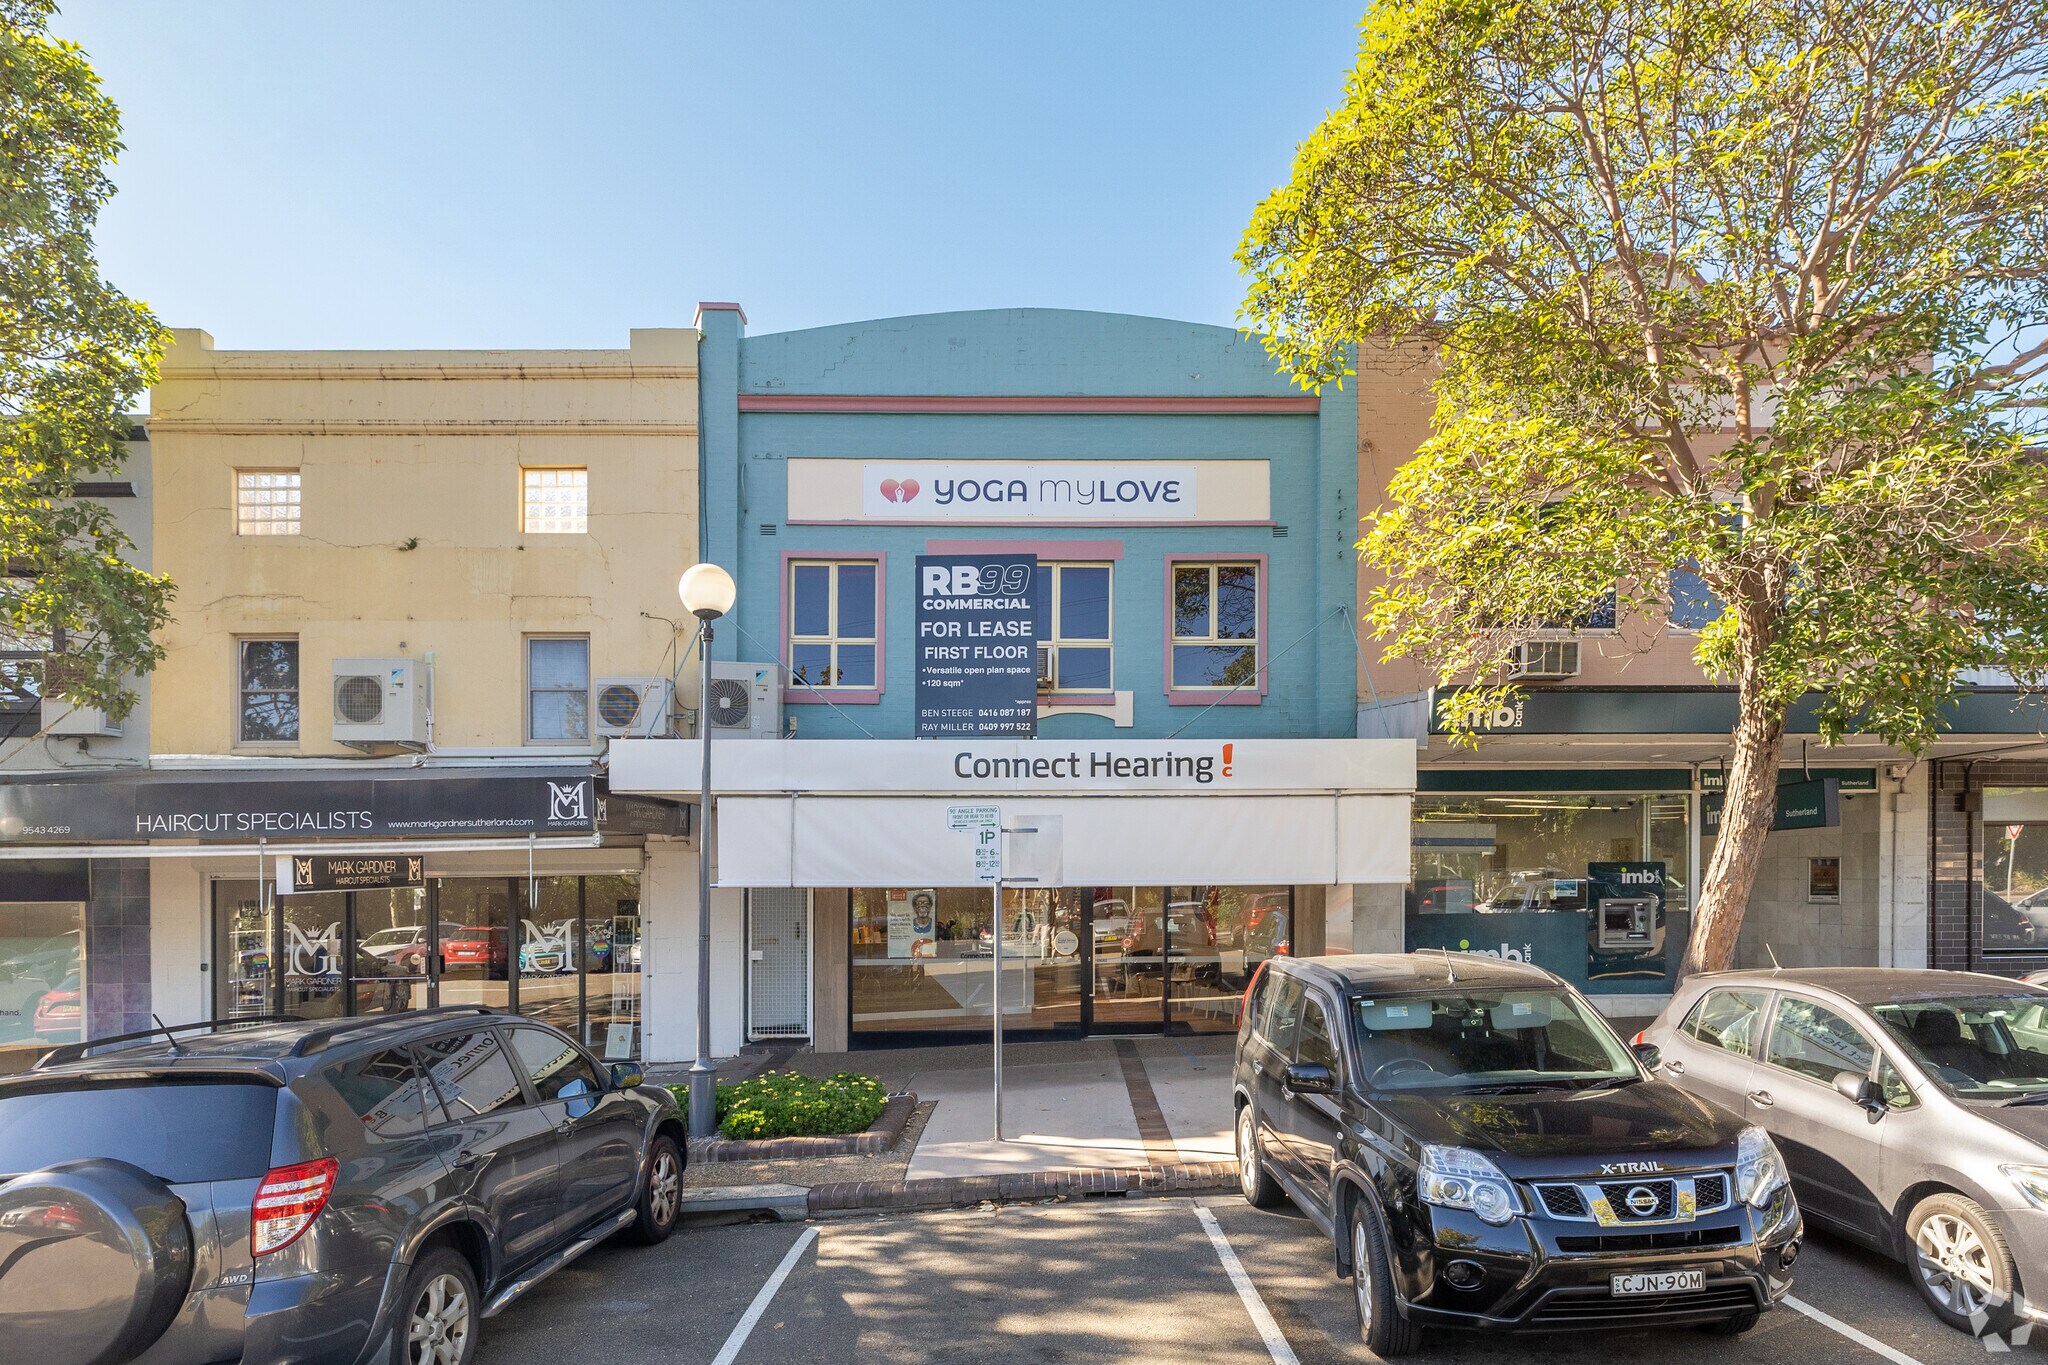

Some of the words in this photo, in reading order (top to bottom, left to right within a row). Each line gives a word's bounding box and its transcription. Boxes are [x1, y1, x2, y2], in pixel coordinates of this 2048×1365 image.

[934, 479, 1028, 505] YOGA
[922, 564, 1030, 596] RB99
[922, 598, 1030, 610] COMMERCIAL
[921, 622, 962, 638] FOR
[968, 620, 1032, 637] LEASE
[924, 646, 970, 660] FIRST
[974, 646, 1028, 659] FLOOR
[986, 666, 1004, 676] plan
[1006, 667, 1031, 676] space
[921, 709, 940, 717] BEN
[941, 709, 974, 717] STEEGE
[978, 708, 998, 717] 0416
[1000, 708, 1014, 716] 087
[1016, 708, 1031, 716] 187
[1514, 701, 1524, 728] bank
[978, 723, 998, 731] 0409
[1000, 723, 1014, 731] 997
[1016, 723, 1031, 731] 522
[954, 752, 1080, 779] Connect
[1090, 752, 1214, 783] Hearing
[1785, 806, 1818, 818] Sutherland
[136, 813, 233, 832] HAIRCUT
[236, 811, 373, 830] SPECIALISTS
[388, 818, 534, 830] www.markgardnersutherland.com
[22, 826, 46, 835] 9543
[47, 826, 71, 834] 4269
[980, 832, 995, 844] 1P
[328, 861, 355, 875] MARK
[356, 860, 396, 874] GARDNER
[336, 877, 359, 885] HAIRCUT
[359, 876, 390, 884] SPECIALISTS
[1621, 867, 1655, 884] imb
[1523, 943, 1532, 964] ank
[1600, 1161, 1664, 1175] X-TRAIL
[221, 1274, 248, 1284] AWD
